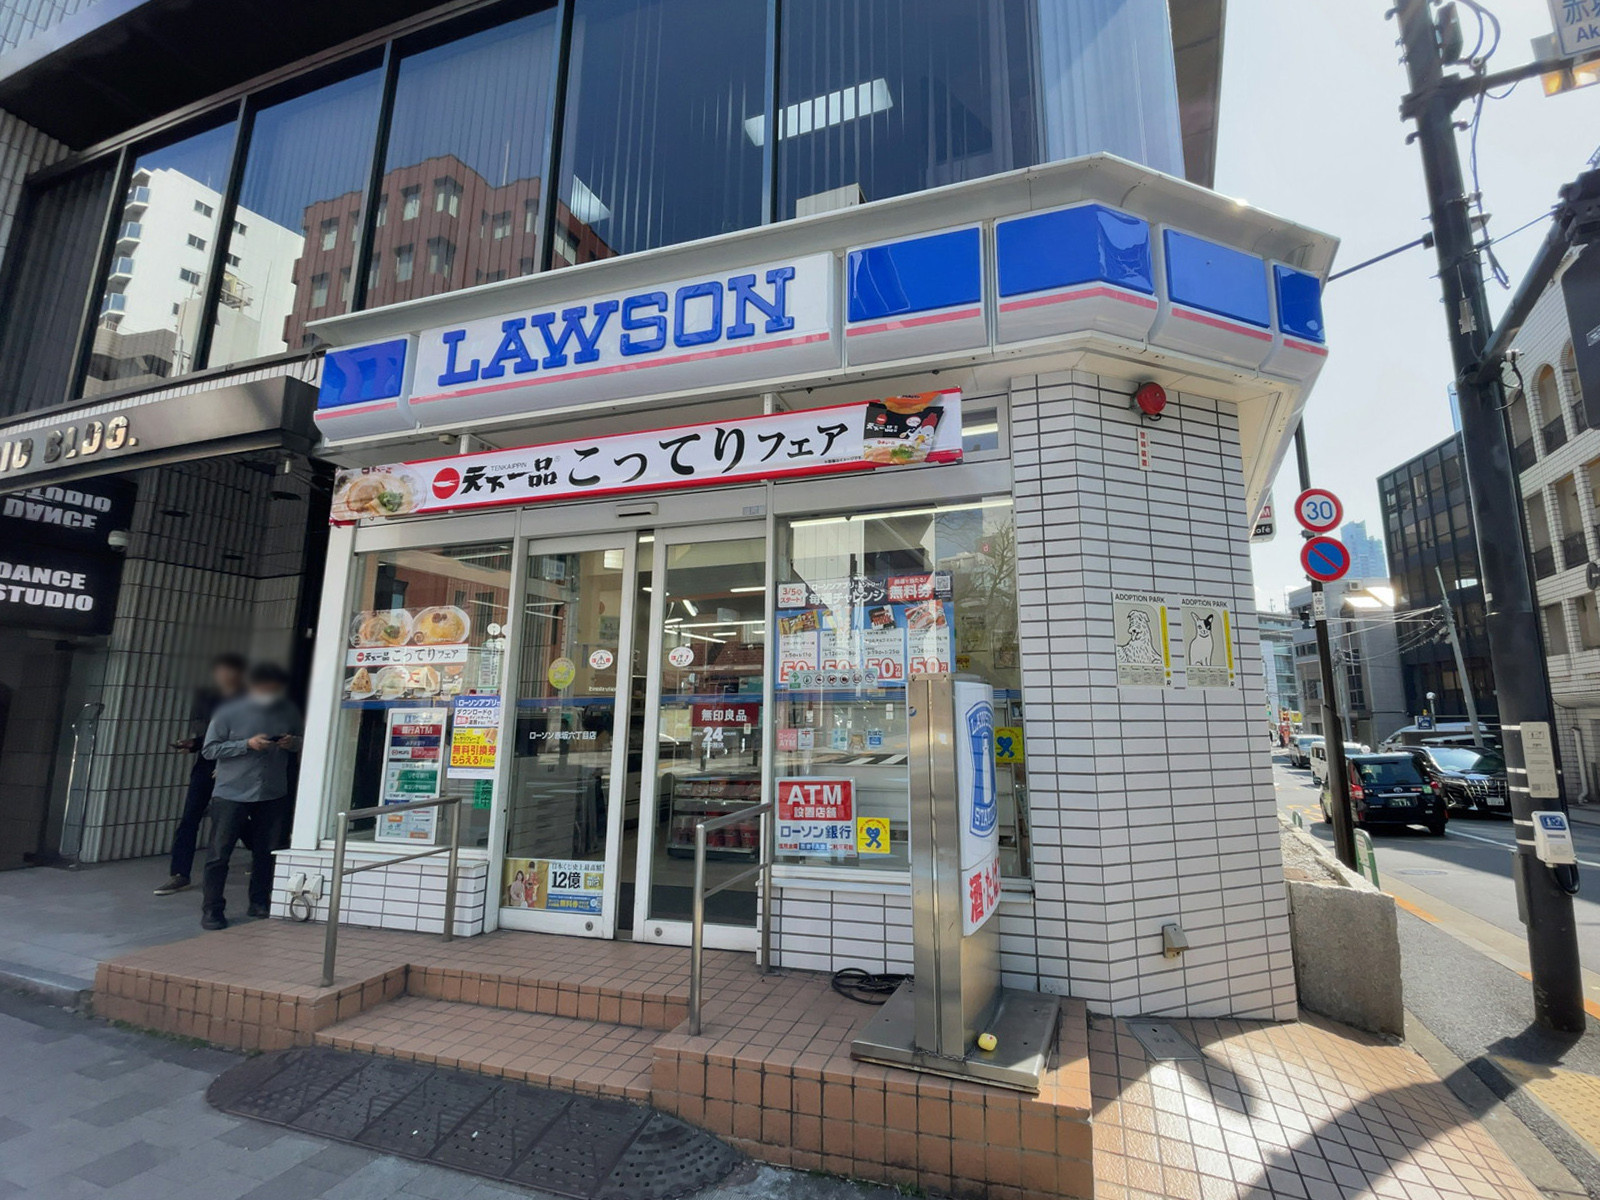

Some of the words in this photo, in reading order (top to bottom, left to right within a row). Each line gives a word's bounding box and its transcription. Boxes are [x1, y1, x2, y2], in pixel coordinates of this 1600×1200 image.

[437, 266, 796, 388] LAWSON
[44, 415, 138, 463] BLDG.
[460, 457, 558, 495] 天下一品
[567, 422, 849, 488] こってりフェア
[490, 462, 527, 472] TENKAIPPIN
[1306, 500, 1333, 521] 30
[0, 561, 87, 590] DANCE
[889, 584, 932, 599] 無料券
[1115, 593, 1147, 602] ADOPTION
[1148, 595, 1165, 604] PARK
[1181, 598, 1211, 607] ADOPTION
[1212, 600, 1228, 608] PARK
[392, 648, 459, 662] こってりフェア
[701, 708, 747, 721] 無印良品
[529, 731, 597, 740] ローソン赤坂六丁目店
[703, 727, 724, 742] 24
[453, 745, 497, 756] 無料引換券
[786, 785, 842, 805] ATM
[794, 807, 837, 818] 設置店舗
[780, 825, 852, 839] ローソン銀行
[551, 871, 581, 889] 12億
[969, 857, 1002, 924] 酒・たば
